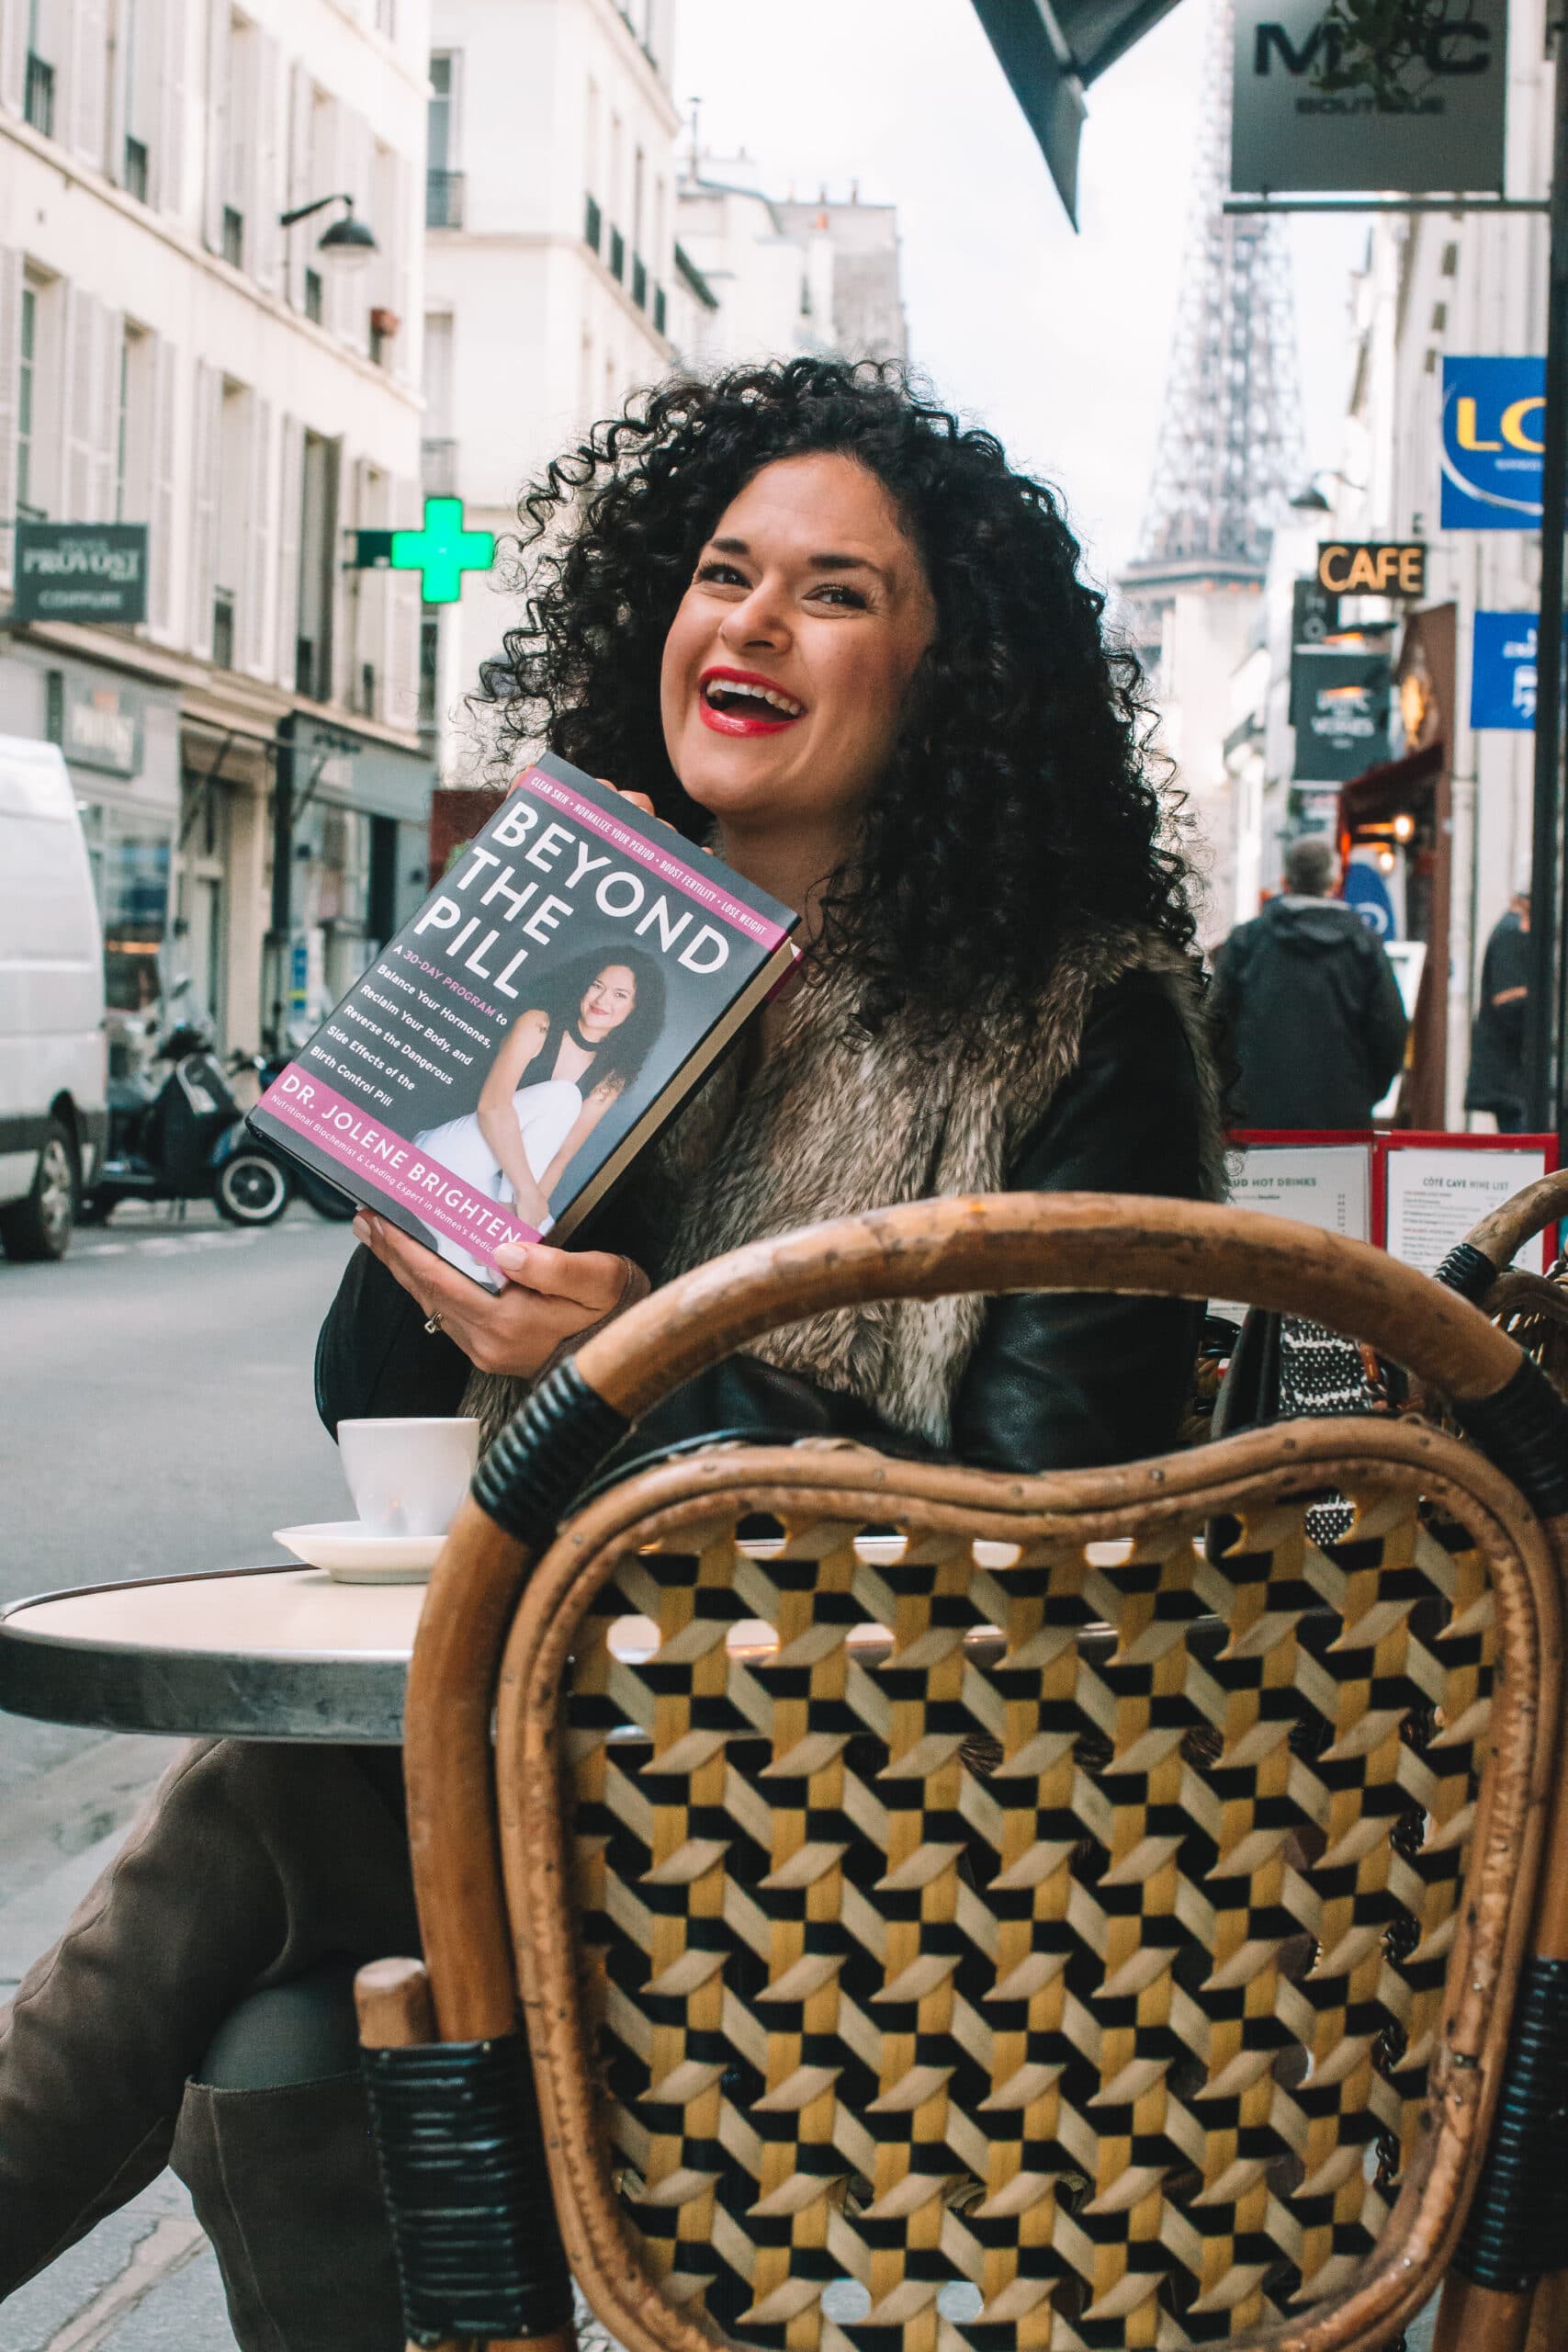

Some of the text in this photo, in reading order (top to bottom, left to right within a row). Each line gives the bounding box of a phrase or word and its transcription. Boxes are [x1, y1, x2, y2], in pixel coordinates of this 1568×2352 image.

[1255, 21, 1491, 75] MC
[1319, 546, 1422, 593] CAFE
[457, 846, 573, 944] THE
[491, 801, 728, 973] BEYOND
[531, 777, 766, 934] CLEAR SKIN NORMALIZE YOUR PERIOD BOOST FERTILITY LOSE WEIGHT
[403, 950, 443, 978] 30-DAY
[443, 977, 496, 1016] PROGRAM
[413, 896, 528, 999] PILL
[344, 1005, 453, 1084] Reverse the Dangerous
[360, 985, 473, 1065] Reclaim Your Body, and
[377, 964, 491, 1049] Balance Your Hormones,
[310, 1046, 392, 1106] Birth Control Pill
[327, 1026, 348, 1044] Side
[349, 1040, 384, 1069] Effects
[398, 1074, 414, 1090] the
[271, 1095, 313, 1125] Nutritional
[313, 1124, 356, 1157] Biochemist
[365, 1159, 395, 1185] Leading
[397, 1182, 423, 1204] Expert
[434, 1207, 468, 1235] Women's
[281, 1075, 521, 1242] DR. JOLENE BRIGHTEN
[1252, 1178, 1274, 1187] HOT
[1277, 1177, 1316, 1187] DRINKS
